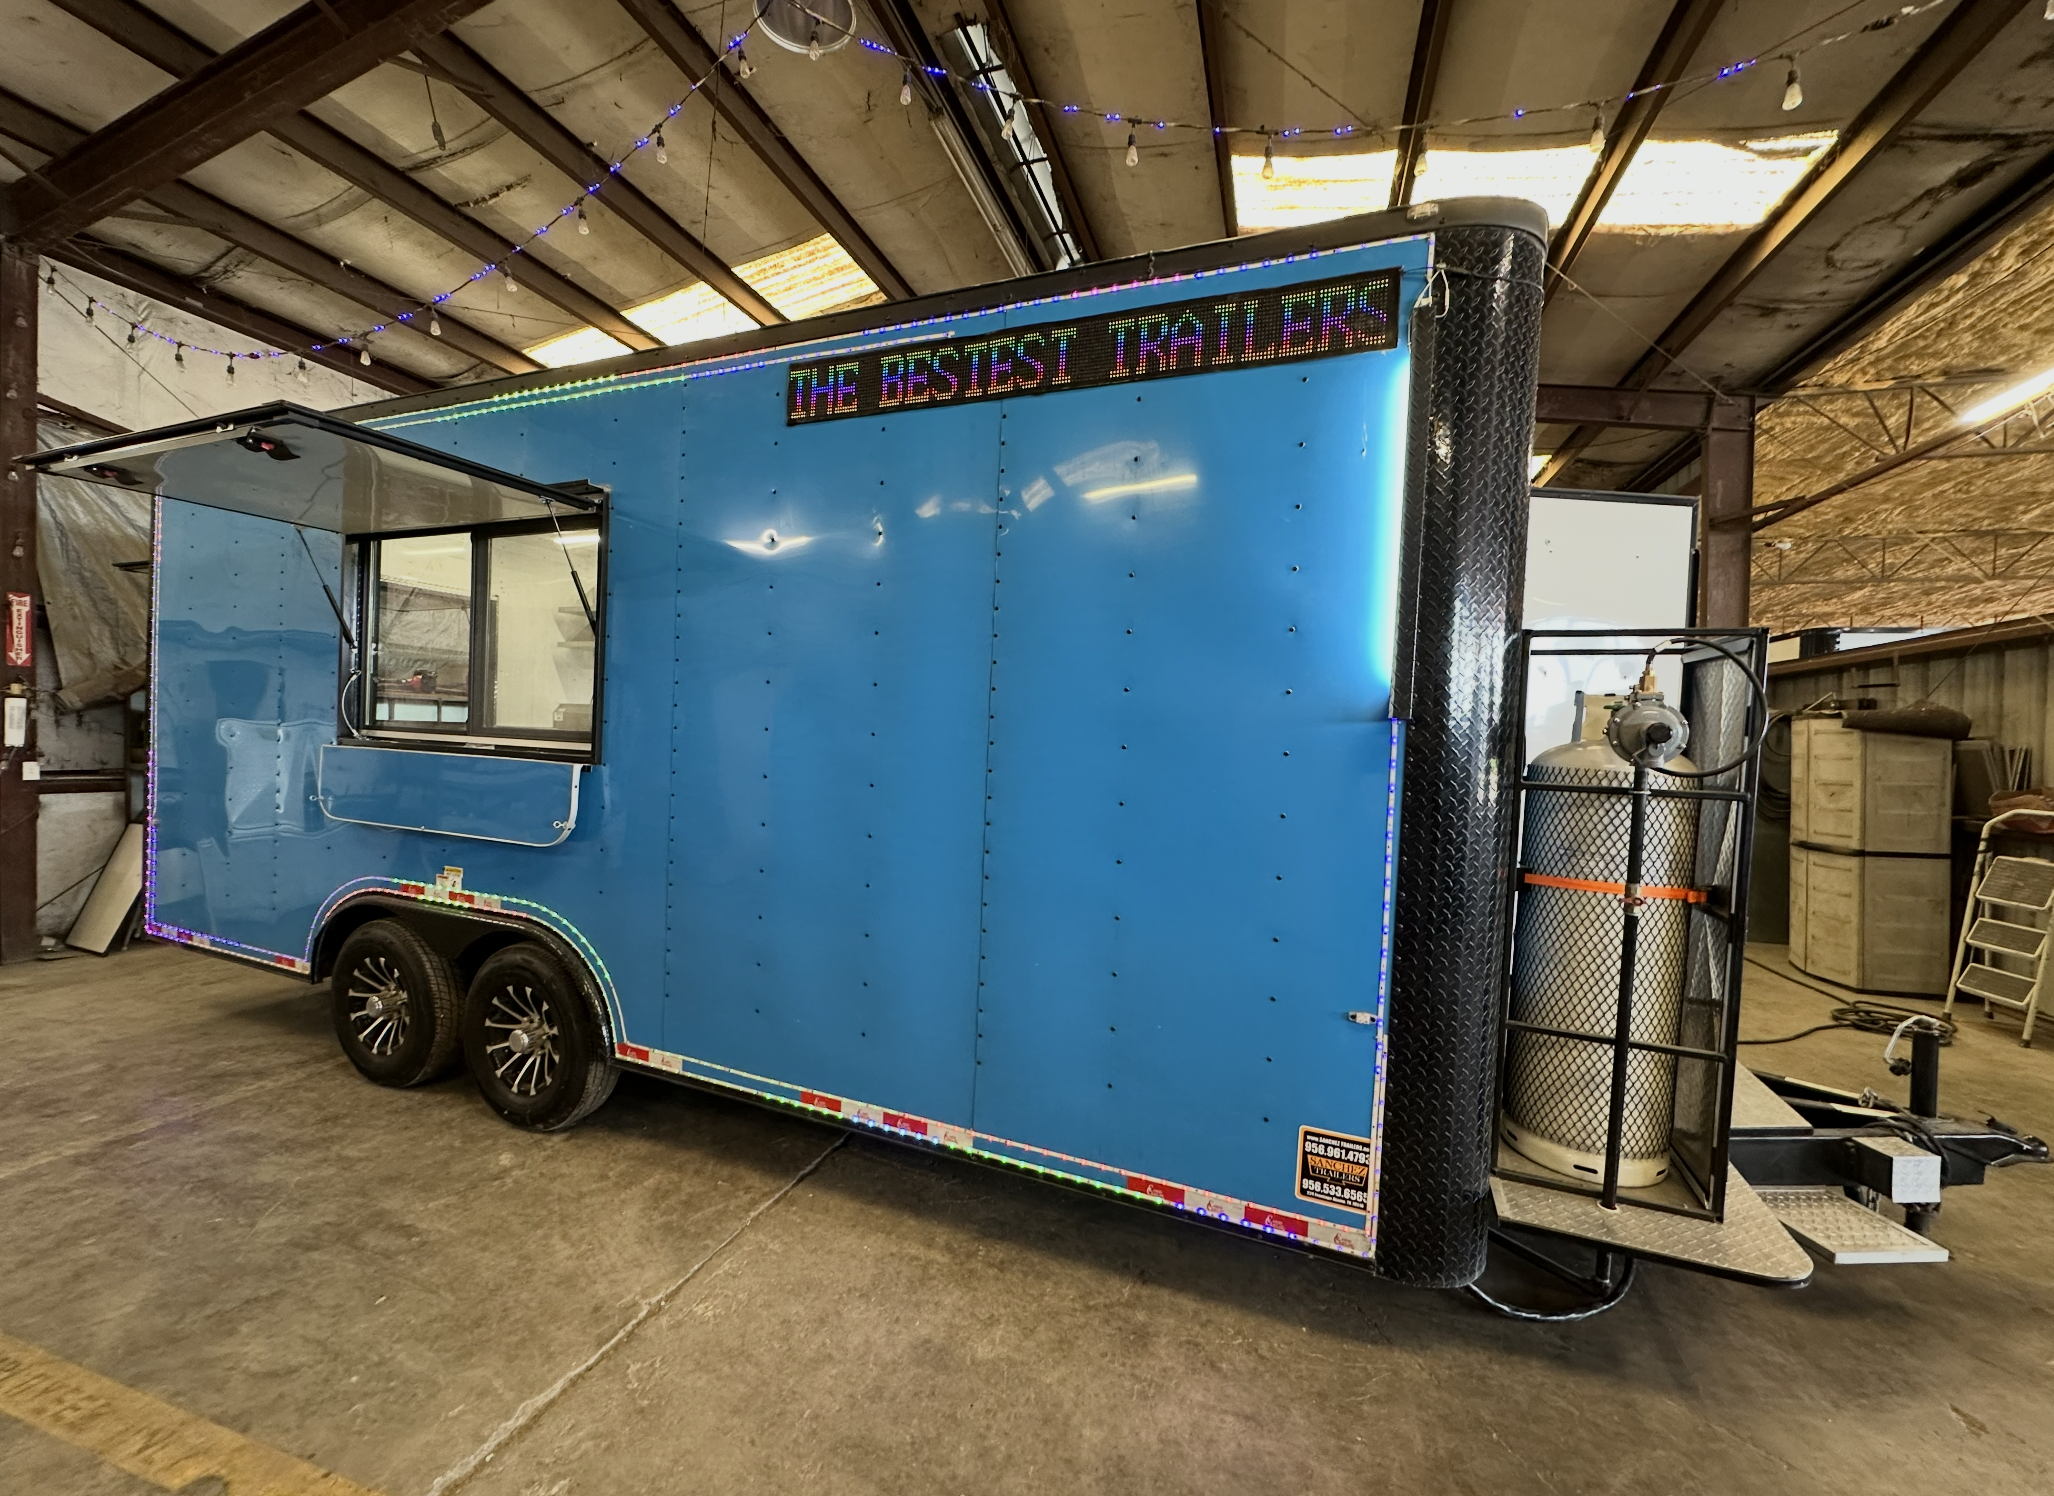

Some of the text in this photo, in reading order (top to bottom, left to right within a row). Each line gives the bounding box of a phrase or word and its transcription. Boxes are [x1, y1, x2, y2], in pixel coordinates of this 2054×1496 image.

[790, 278, 1389, 419] THE BESTEST TRAILERS
[15, 608, 24, 661] EXTINGUISHER
[1310, 1156, 1366, 1176] SANCHEZ
[1314, 1167, 1361, 1183] TRAILERS
